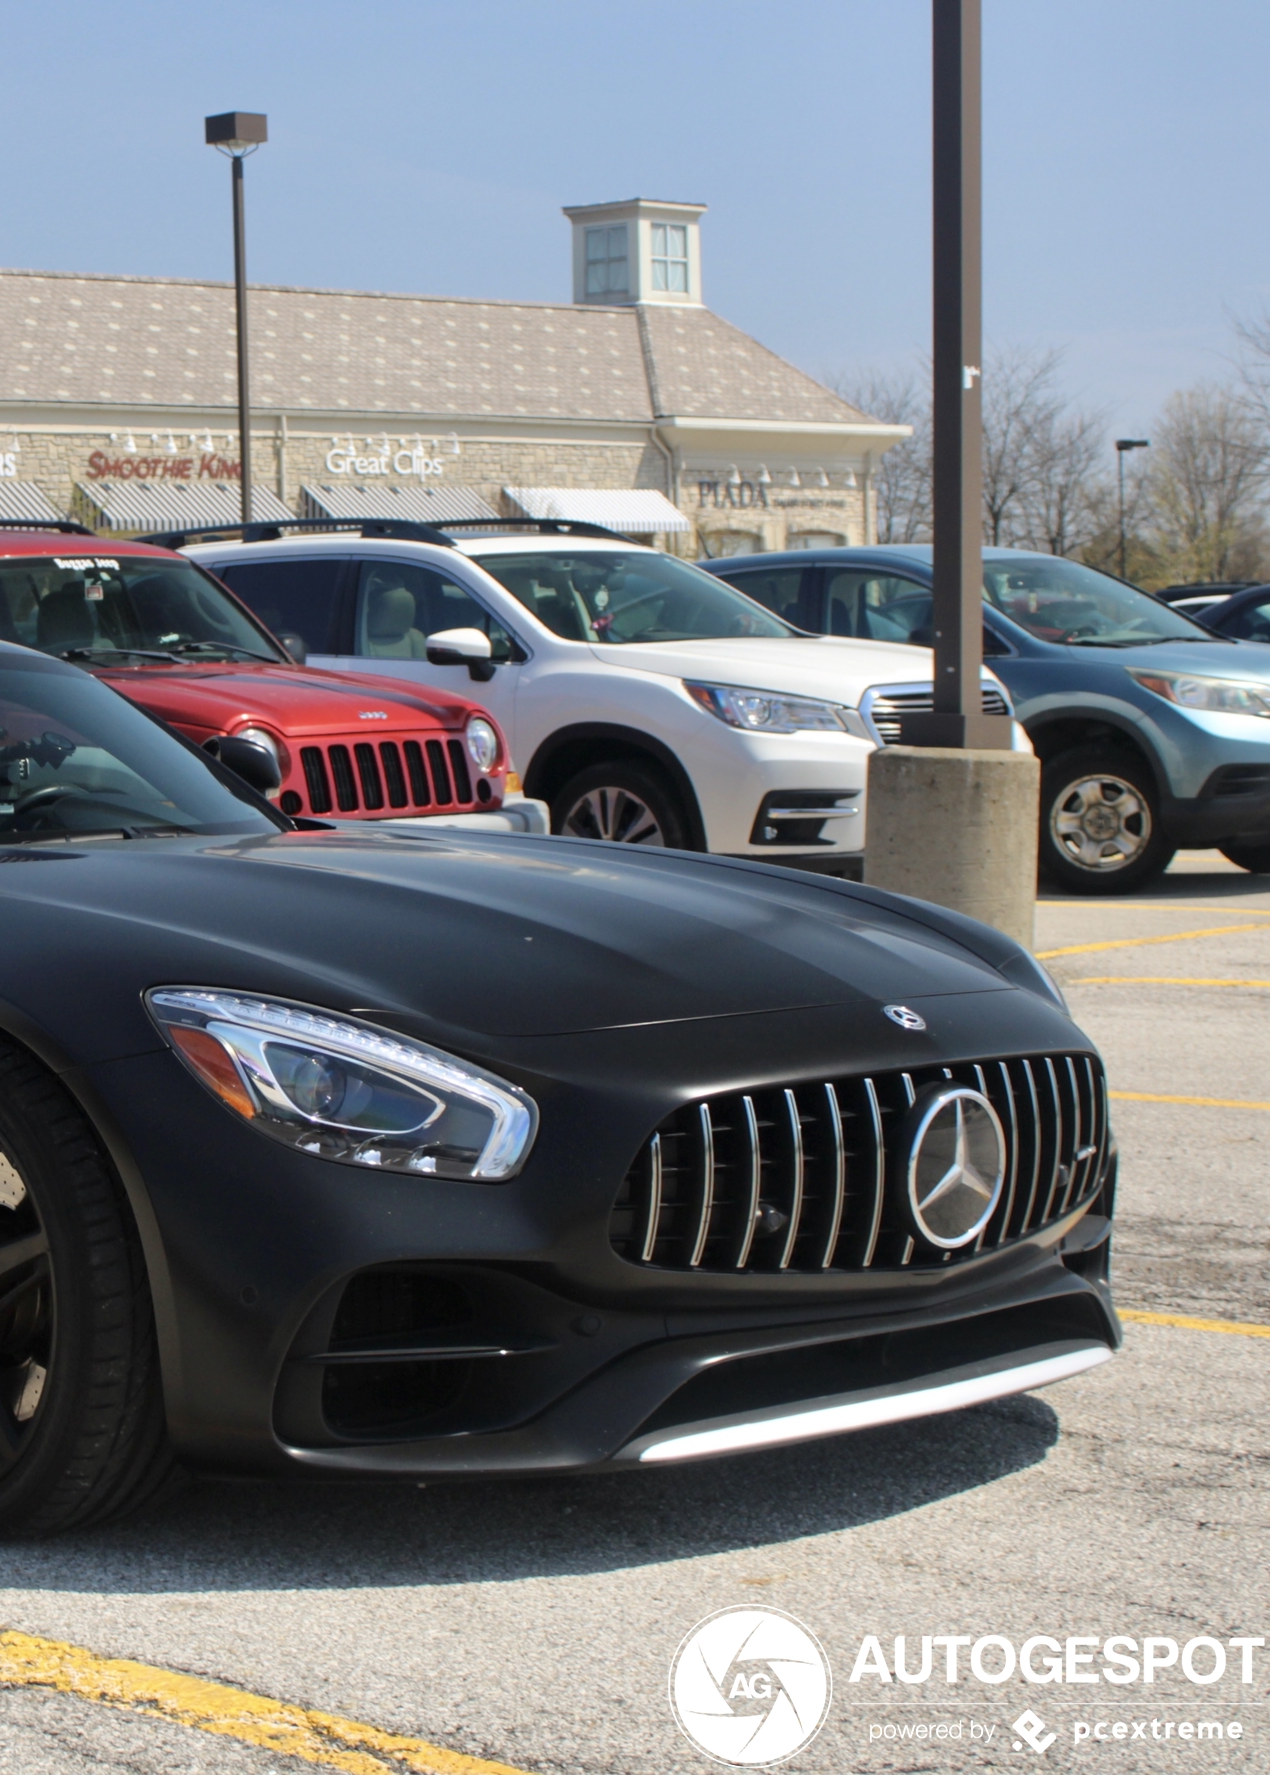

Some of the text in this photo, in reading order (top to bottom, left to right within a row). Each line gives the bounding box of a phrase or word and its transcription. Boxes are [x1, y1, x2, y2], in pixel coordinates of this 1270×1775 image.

[86, 451, 193, 480] SMOOTHIE
[326, 449, 444, 482] Great Clips
